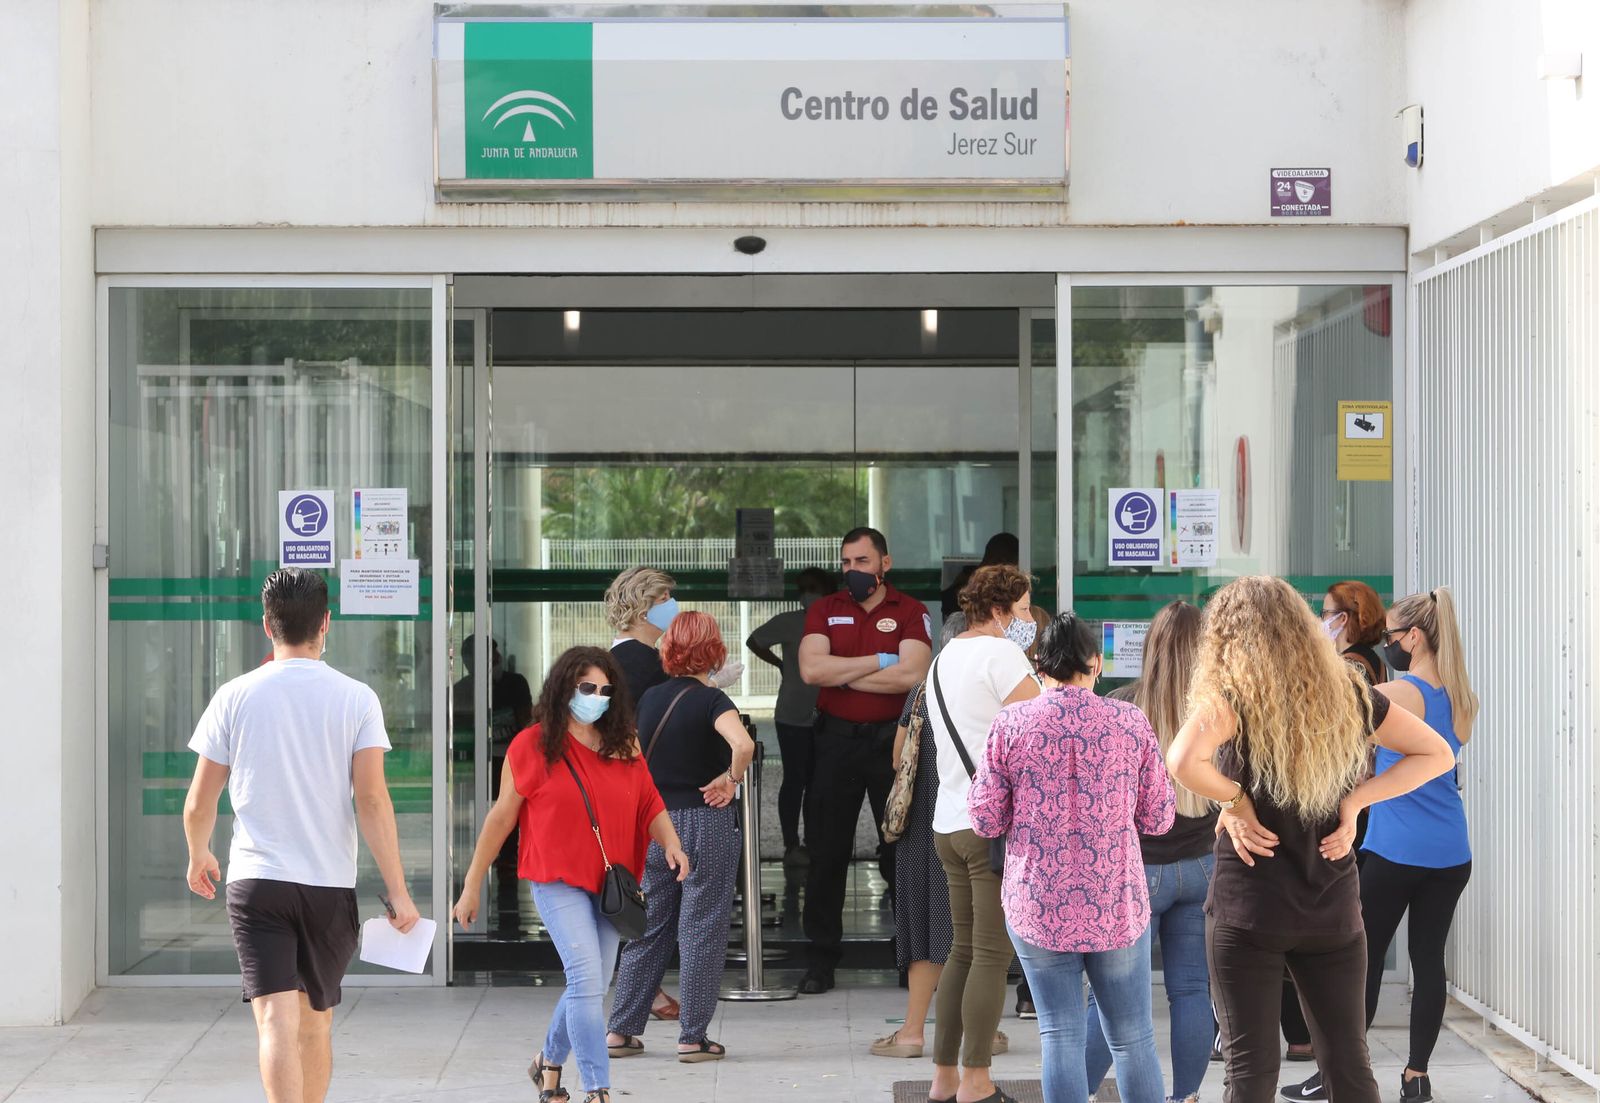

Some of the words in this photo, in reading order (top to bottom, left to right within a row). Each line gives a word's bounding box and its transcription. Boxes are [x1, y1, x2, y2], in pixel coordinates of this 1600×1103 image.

[780, 86, 890, 121] Centro
[900, 87, 938, 121] de
[949, 86, 1039, 121] Salud
[481, 147, 509, 158] JUNTA
[514, 147, 525, 158] DE
[529, 147, 578, 158] ANDALUCIA
[947, 132, 998, 156] Jerez
[1003, 132, 1037, 155] Sur
[1277, 181, 1291, 192] 24
